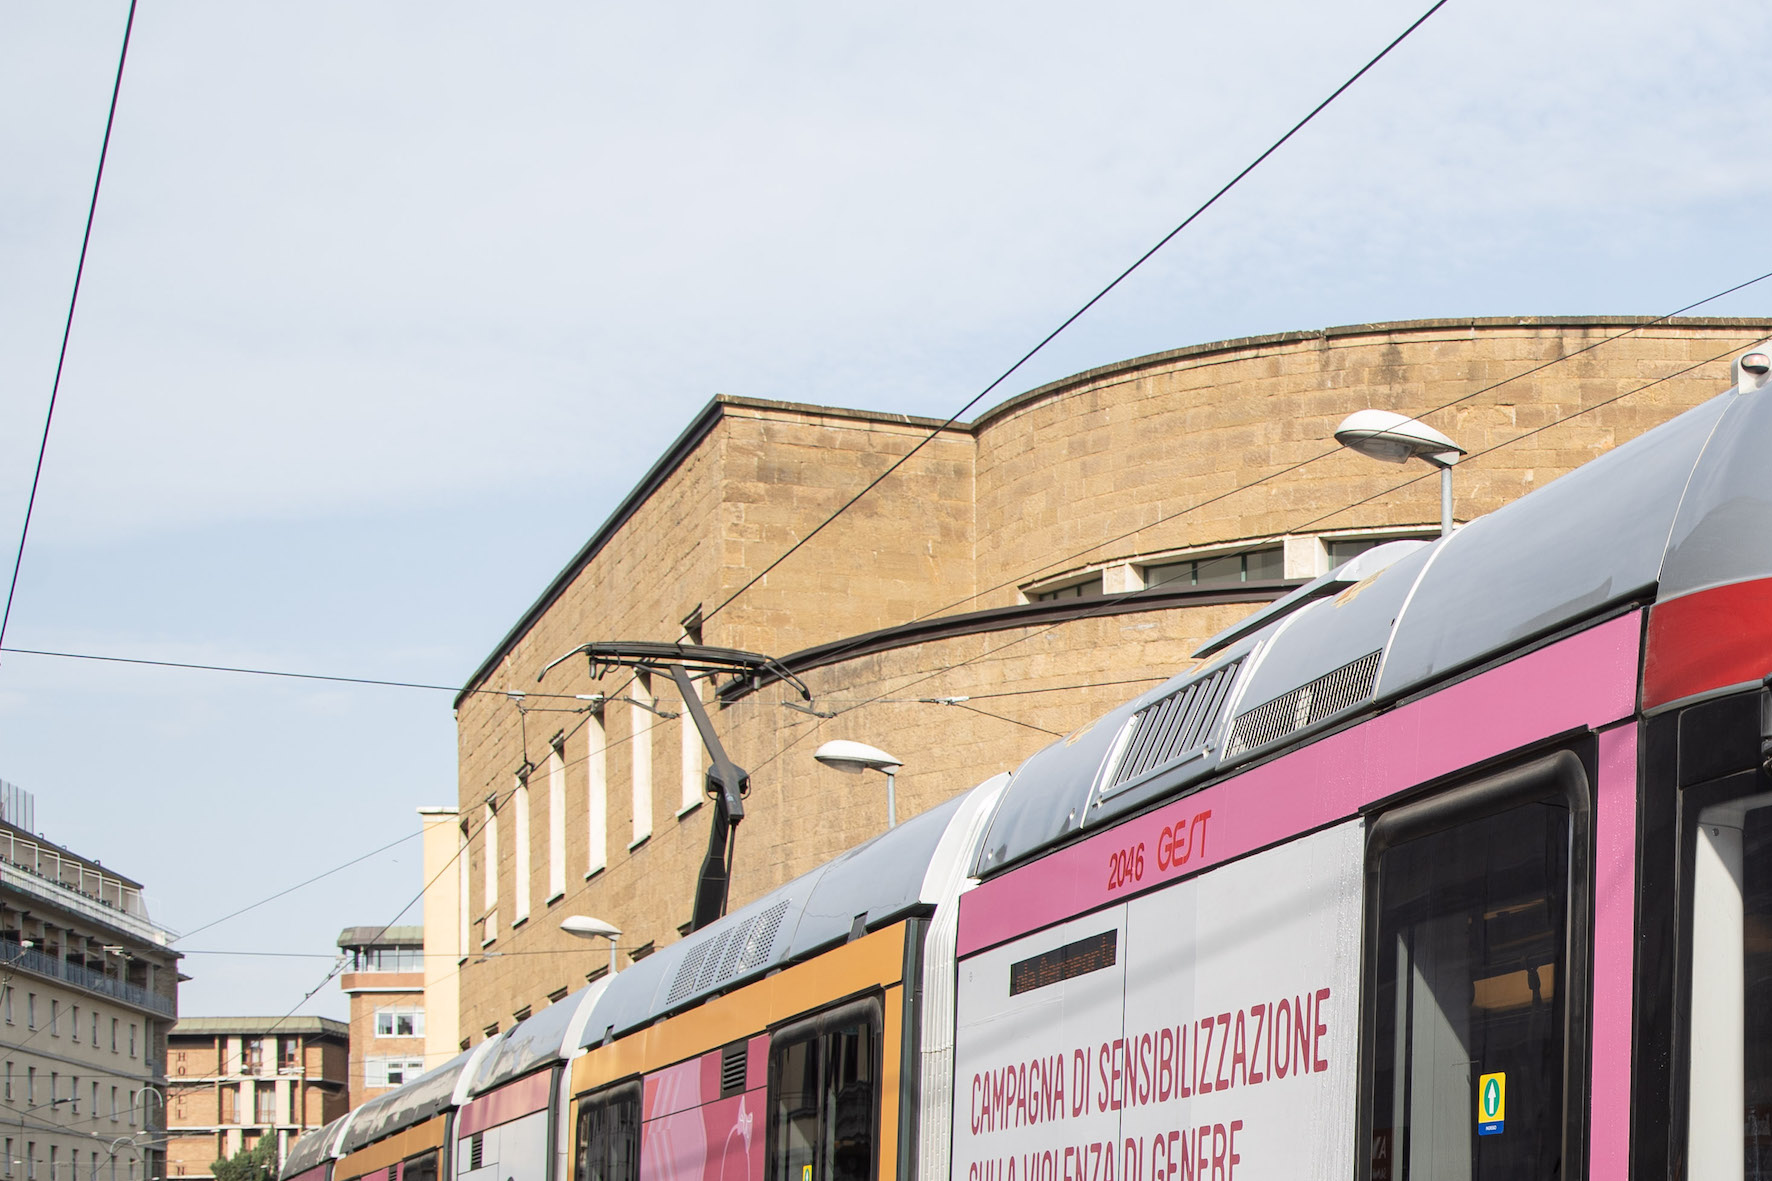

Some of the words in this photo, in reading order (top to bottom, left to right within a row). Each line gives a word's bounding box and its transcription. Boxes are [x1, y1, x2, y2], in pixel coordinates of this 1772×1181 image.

[1108, 842, 1145, 890] 2046
[1158, 810, 1212, 871] GEST
[971, 1052, 1064, 1135] CAMPAGNA
[1073, 1046, 1091, 1118] DI
[1098, 987, 1331, 1113] SENSIBILIZZAZIONE
